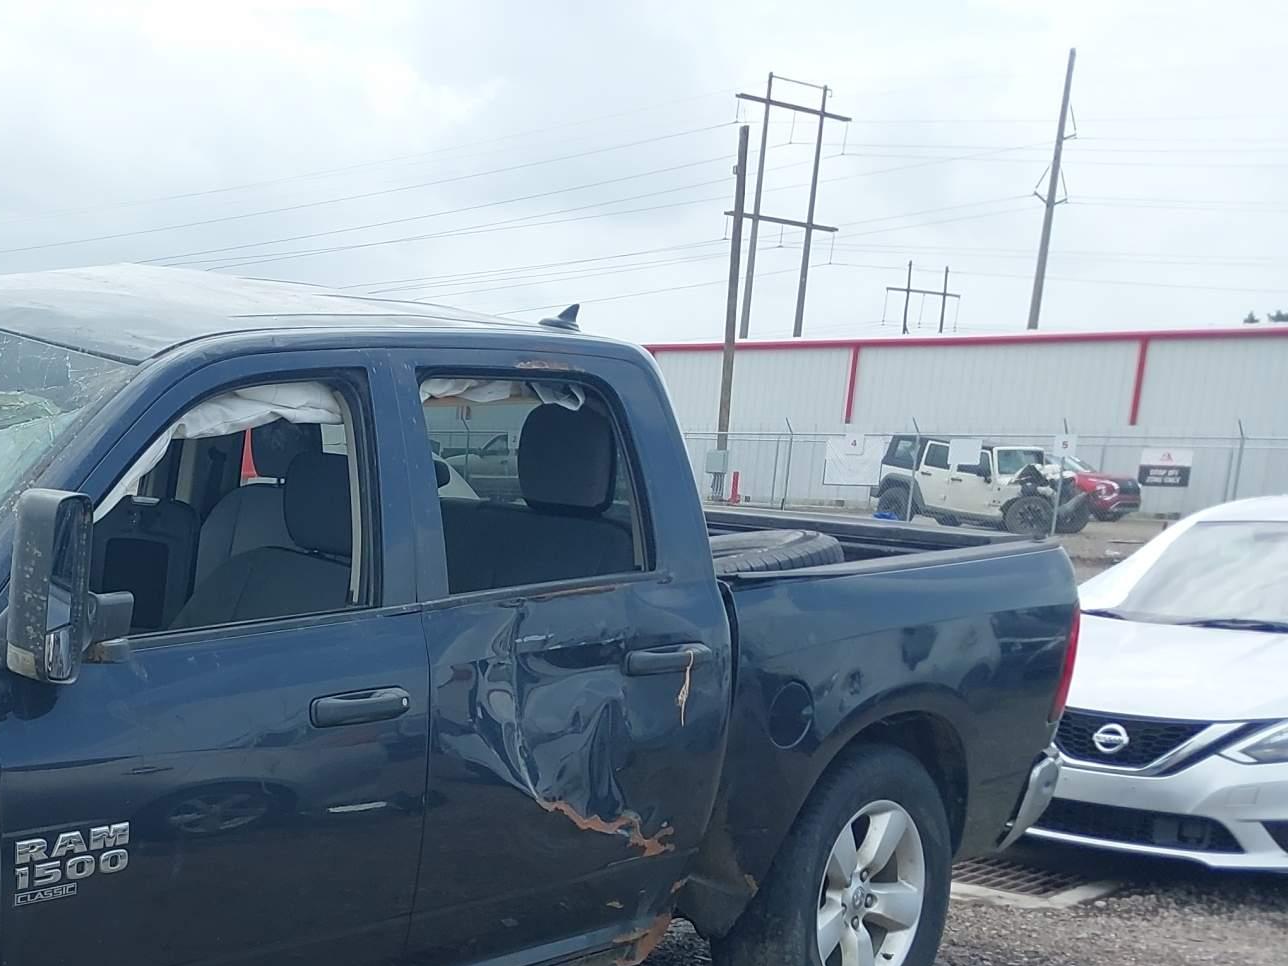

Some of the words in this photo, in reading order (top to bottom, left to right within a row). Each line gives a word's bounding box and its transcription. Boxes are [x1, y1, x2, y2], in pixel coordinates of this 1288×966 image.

[1062, 440, 1069, 449] 5
[15, 821, 130, 865] RAM
[15, 849, 129, 889] 1500
[16, 883, 76, 905] CLASSIC
